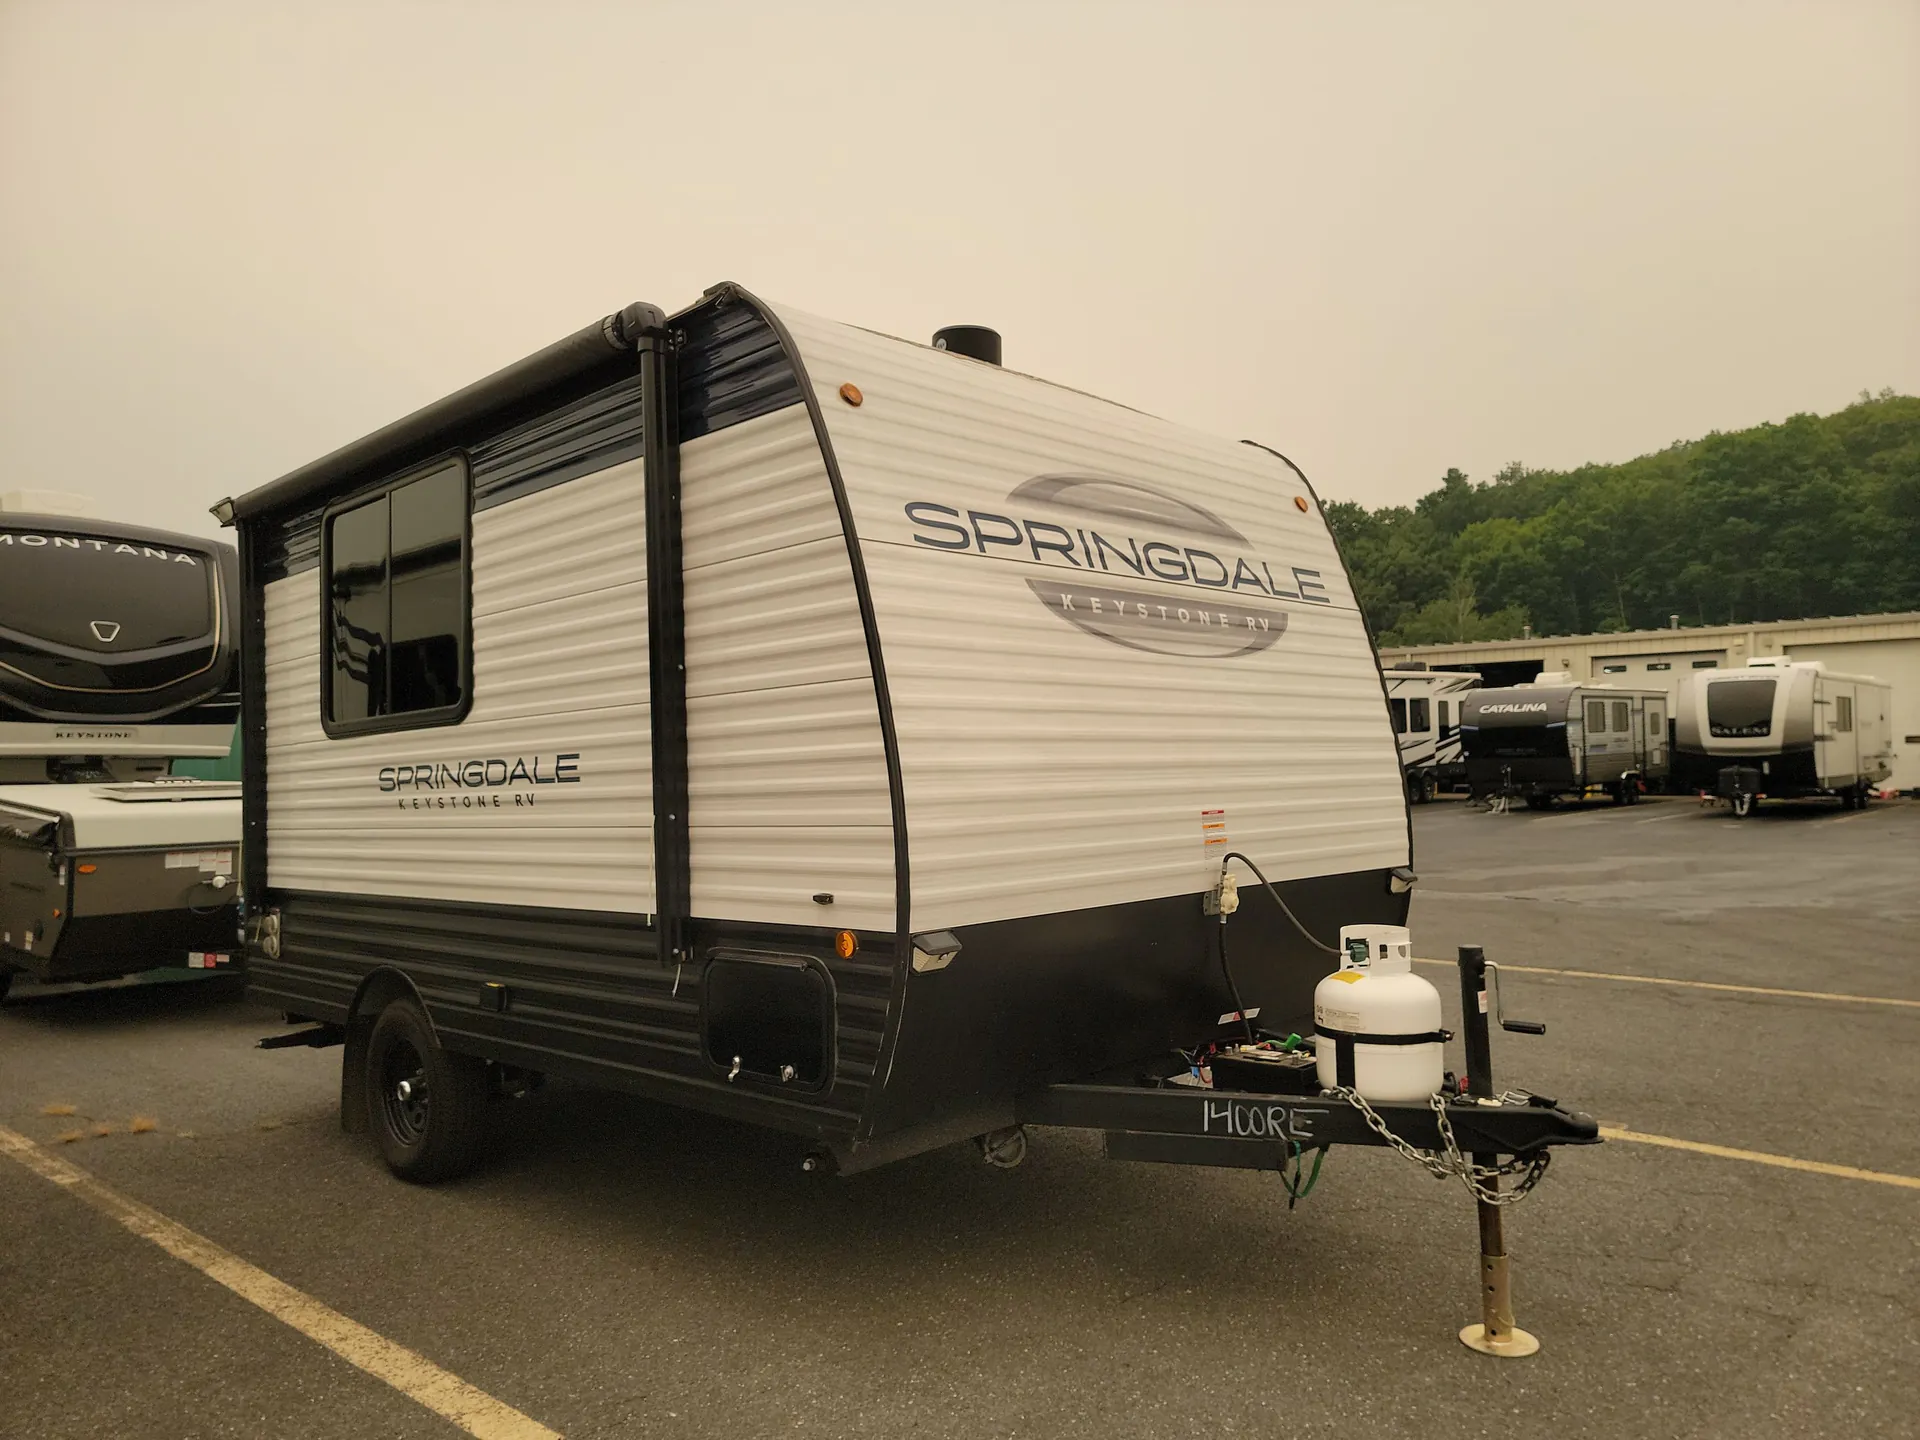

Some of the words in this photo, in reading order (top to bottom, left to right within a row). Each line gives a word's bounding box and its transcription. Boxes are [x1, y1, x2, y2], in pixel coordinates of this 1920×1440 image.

[903, 501, 1331, 604] SPRINGDALE
[1060, 593, 1230, 629] KEYSTONE
[1245, 616, 1270, 633] RV
[1479, 702, 1547, 714] CATALINA
[55, 731, 132, 739] KEYSTONE
[378, 753, 581, 792] SPRINGDALE
[398, 794, 502, 811] KEYSTONE
[514, 793, 536, 807] RV
